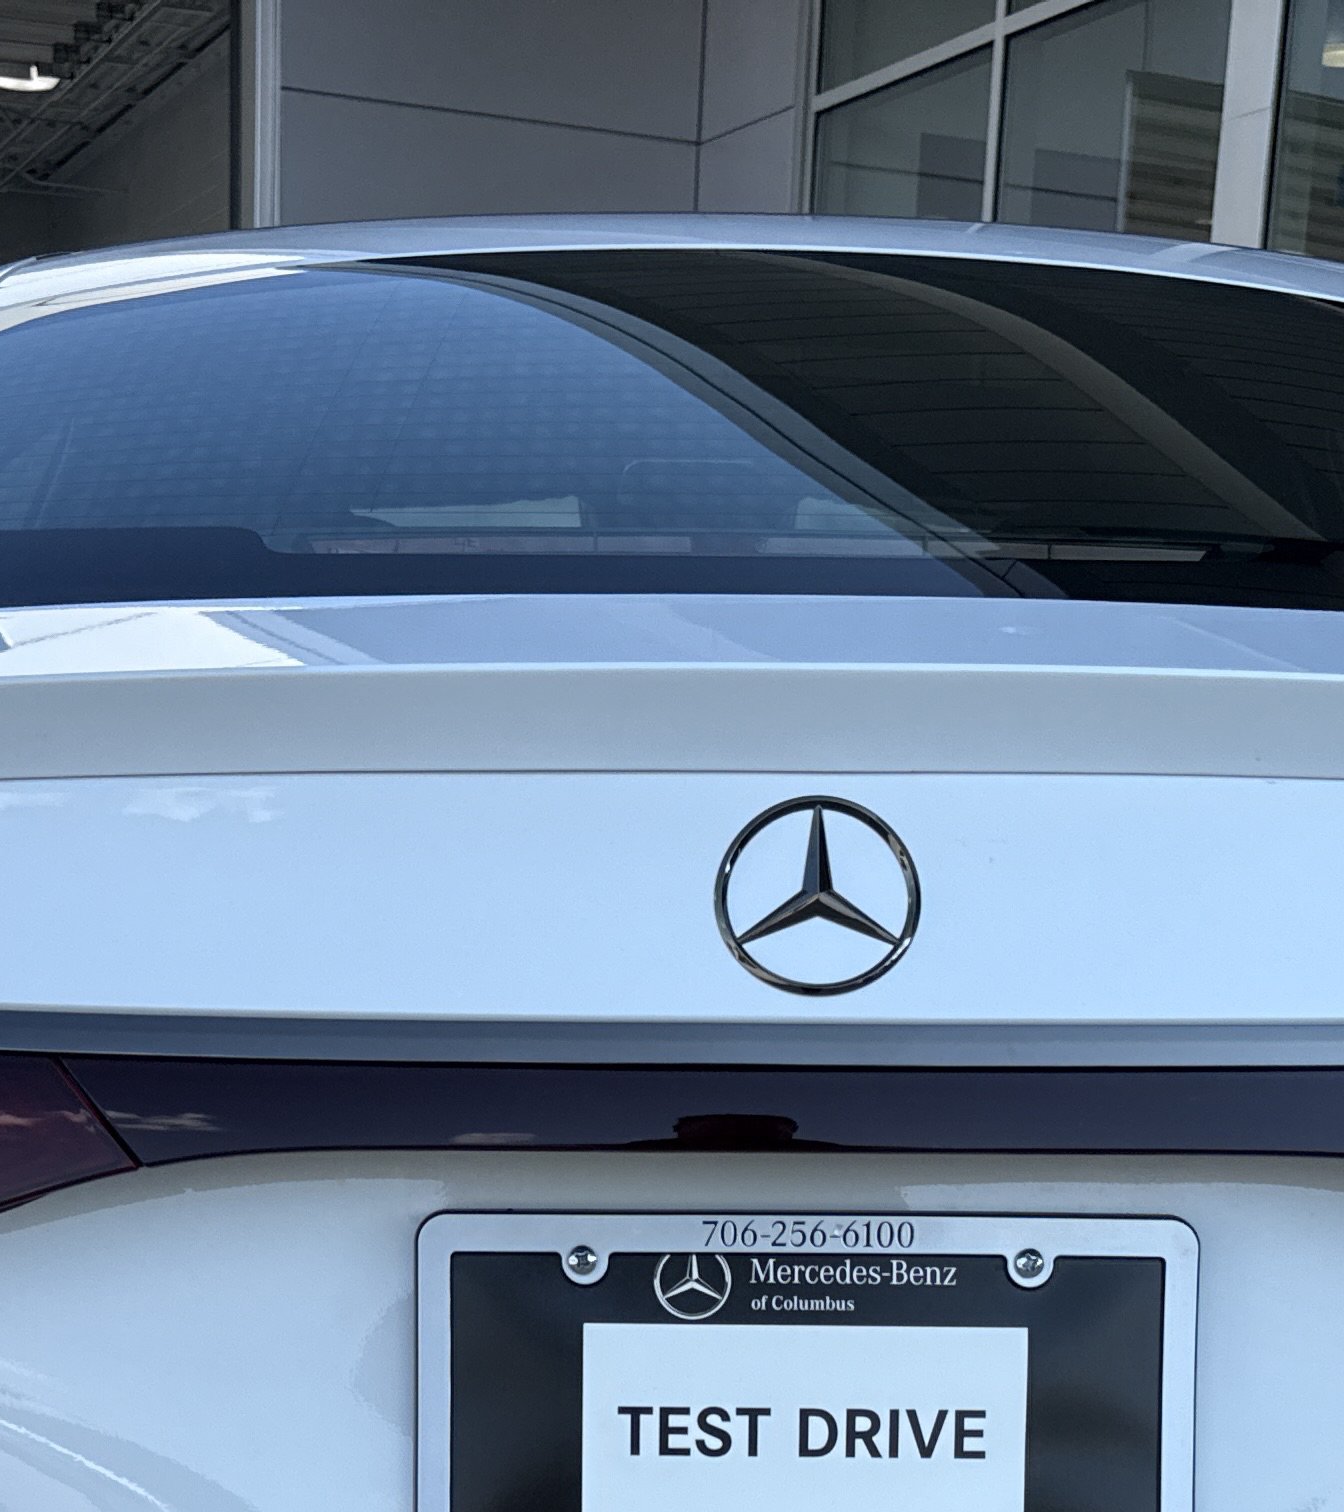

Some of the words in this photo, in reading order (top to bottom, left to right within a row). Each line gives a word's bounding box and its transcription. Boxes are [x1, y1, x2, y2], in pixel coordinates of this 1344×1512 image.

[702, 1219, 915, 1248] 706-256-6100
[750, 1258, 957, 1286] Mercedes-Benz
[751, 1295, 767, 1311] of
[771, 1295, 855, 1311] Columbus
[617, 1406, 771, 1457] TEST
[798, 1407, 986, 1459] DRIVE
